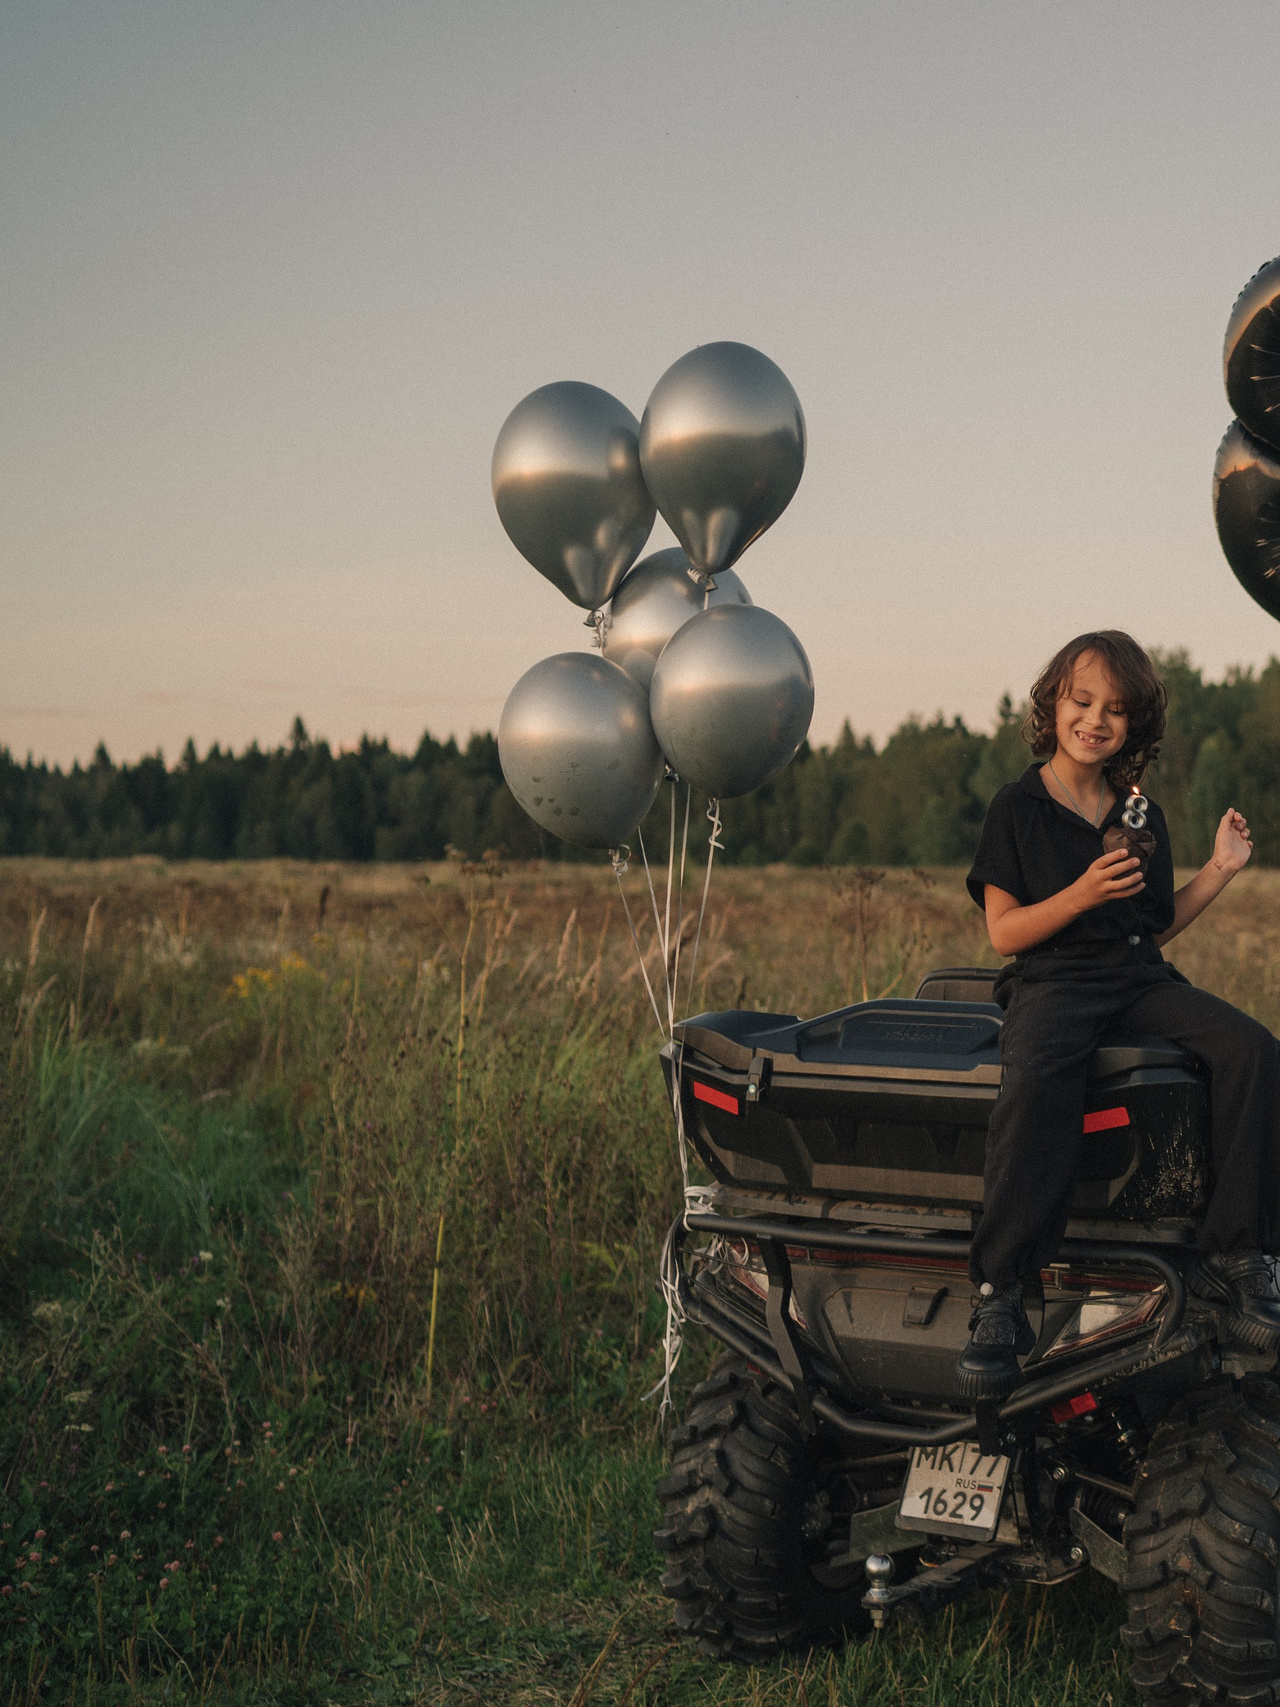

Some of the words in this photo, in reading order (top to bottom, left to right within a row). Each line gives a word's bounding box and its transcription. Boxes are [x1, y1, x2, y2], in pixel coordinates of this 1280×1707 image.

[1122, 795, 1149, 829] 8
[916, 1445, 960, 1473] MK
[955, 1478, 977, 1490] RUS
[918, 1487, 985, 1521] 1629
